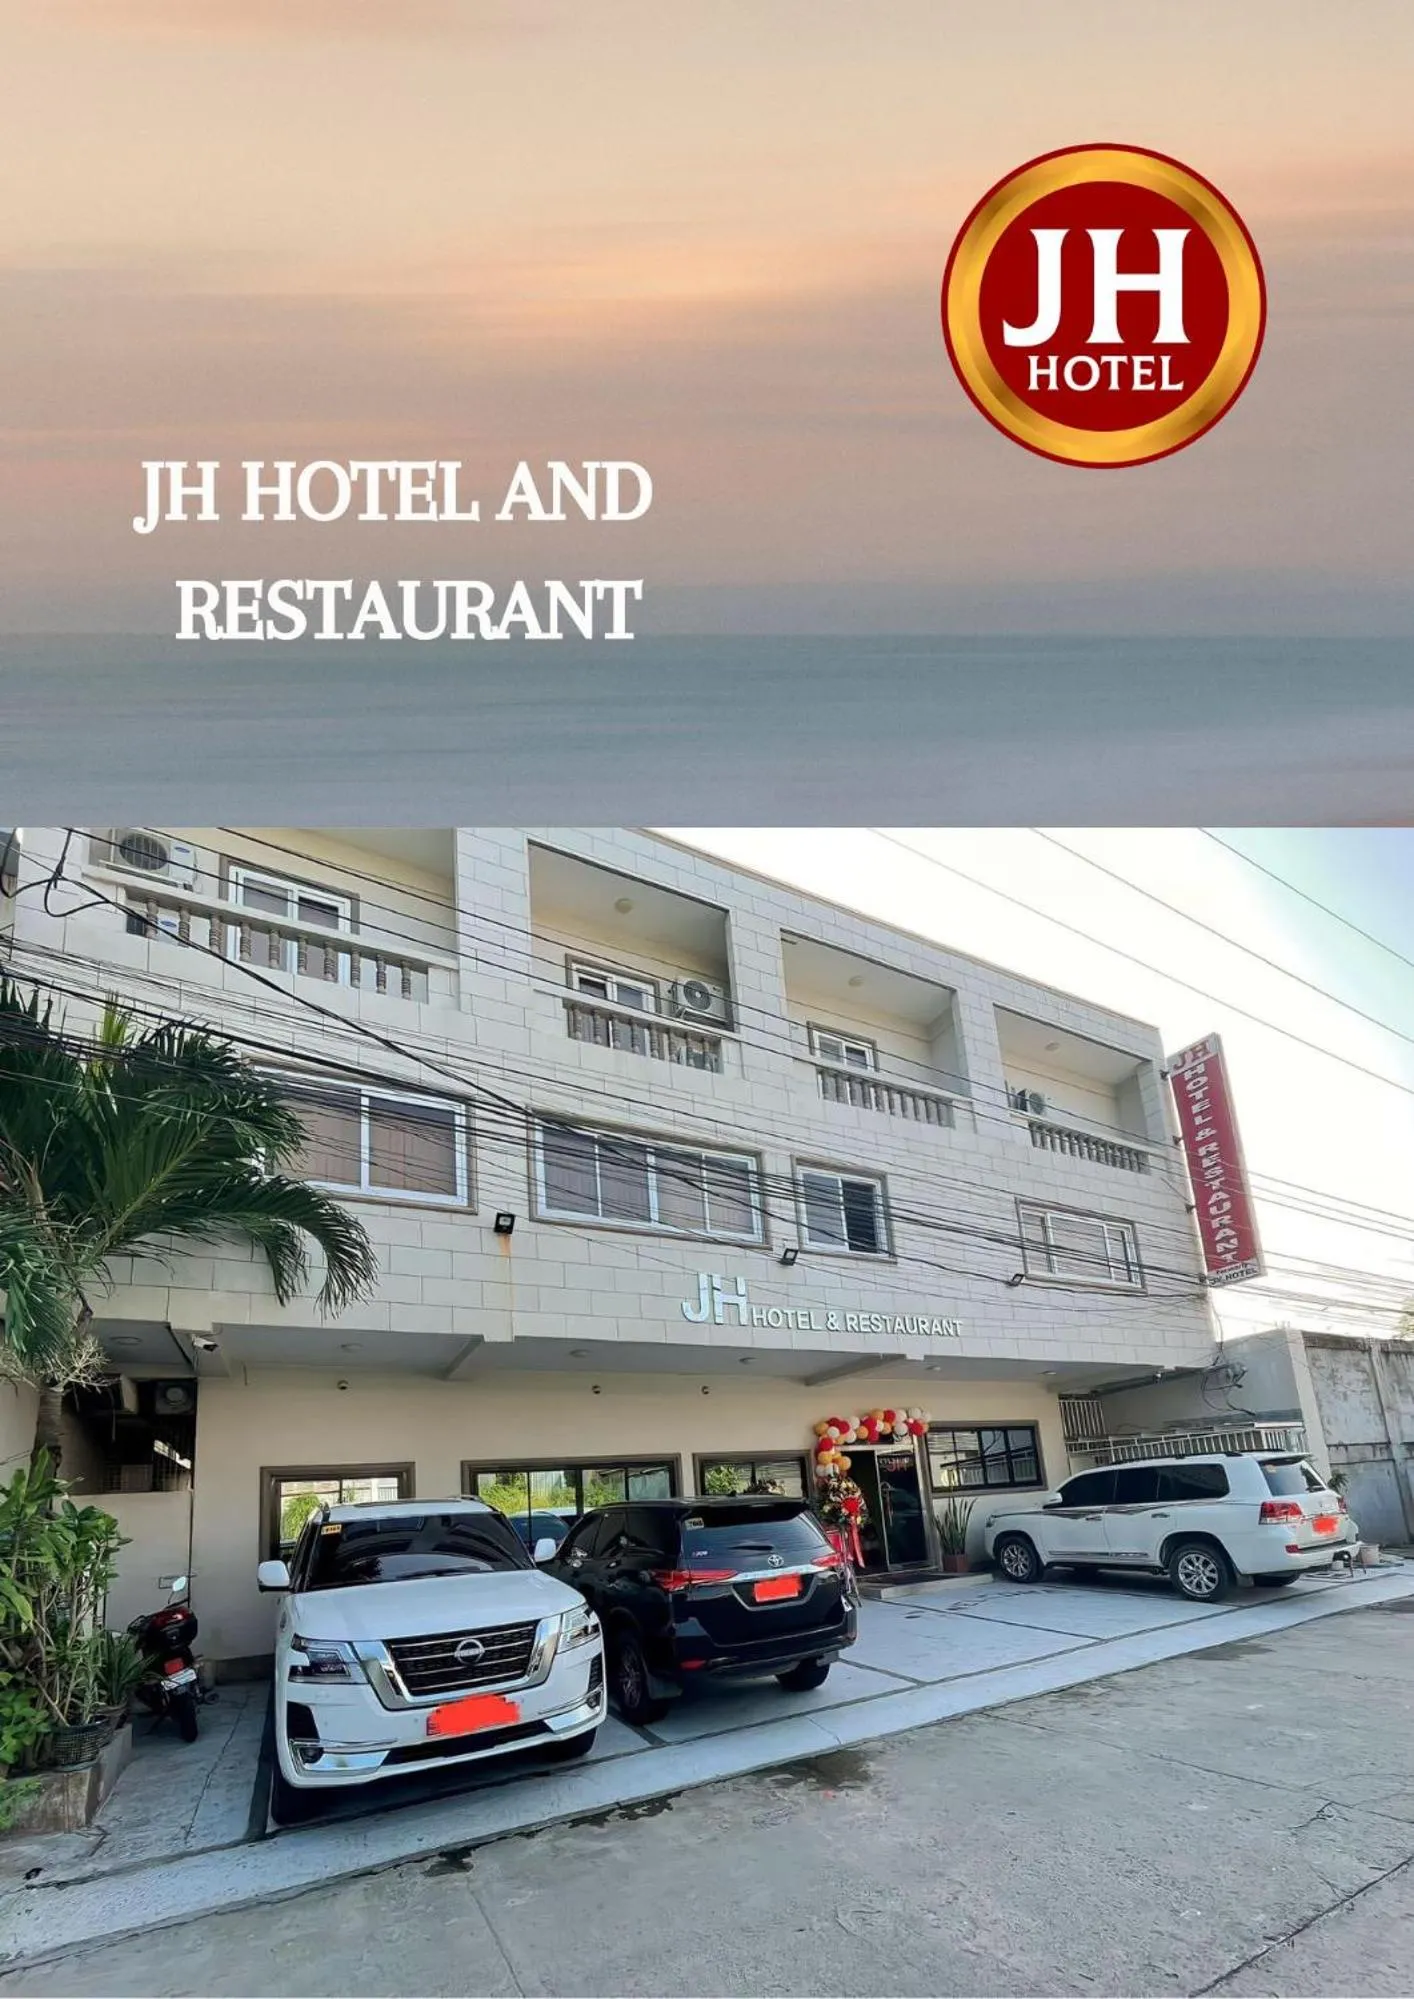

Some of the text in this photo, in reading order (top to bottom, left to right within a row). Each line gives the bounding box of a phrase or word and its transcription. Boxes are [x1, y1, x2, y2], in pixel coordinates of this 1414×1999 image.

[1184, 1063, 1239, 1263] HOTEL & RESTAURANT
[681, 1271, 963, 1337] JH HOTEL & RESTAURANT
